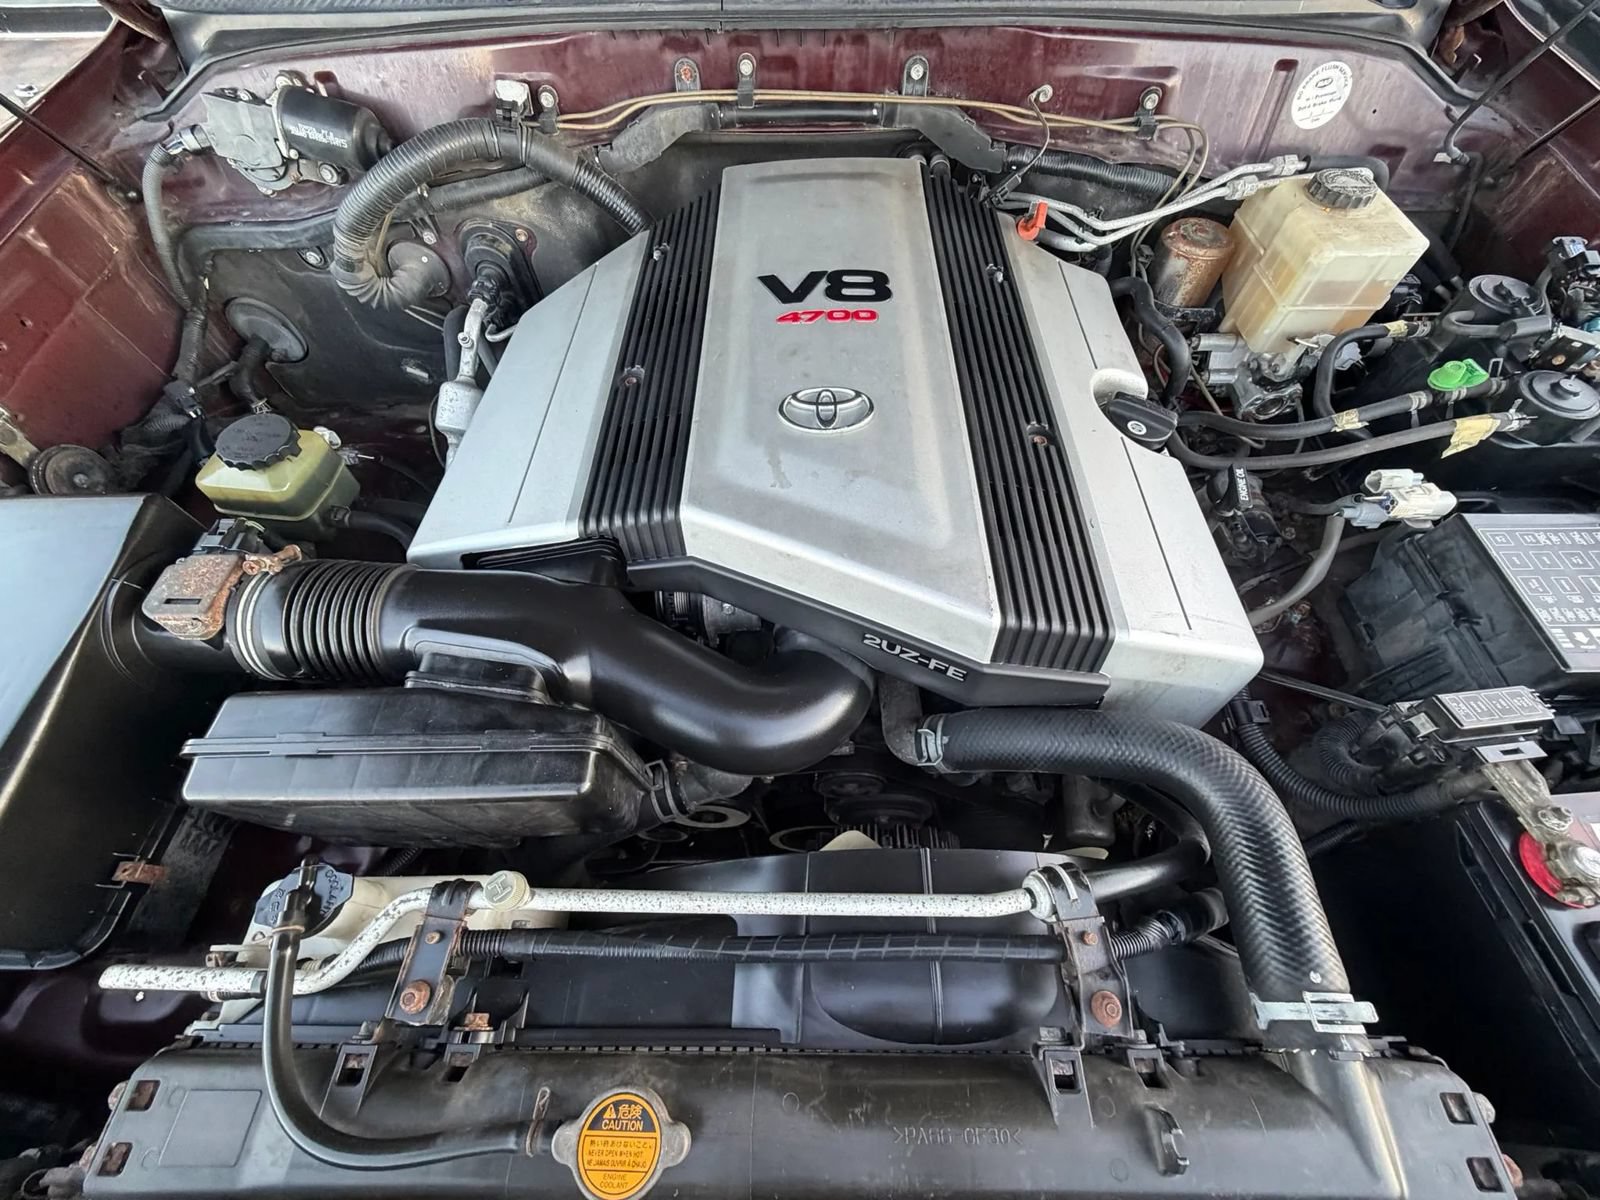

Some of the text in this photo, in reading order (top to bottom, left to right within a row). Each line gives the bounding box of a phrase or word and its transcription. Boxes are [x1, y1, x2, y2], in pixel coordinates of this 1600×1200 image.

[757, 269, 893, 304] V8
[775, 308, 879, 325] 4700
[1237, 478, 1249, 501] ENGINE
[863, 633, 967, 682] 2UZ-FE
[617, 1103, 643, 1120] 危険
[601, 1119, 644, 1132] CAUTION
[588, 1149, 644, 1159] NEVER OPEN WHEN HOT
[599, 1181, 629, 1190] COOLANT
[602, 1173, 628, 1182] ENGINE
